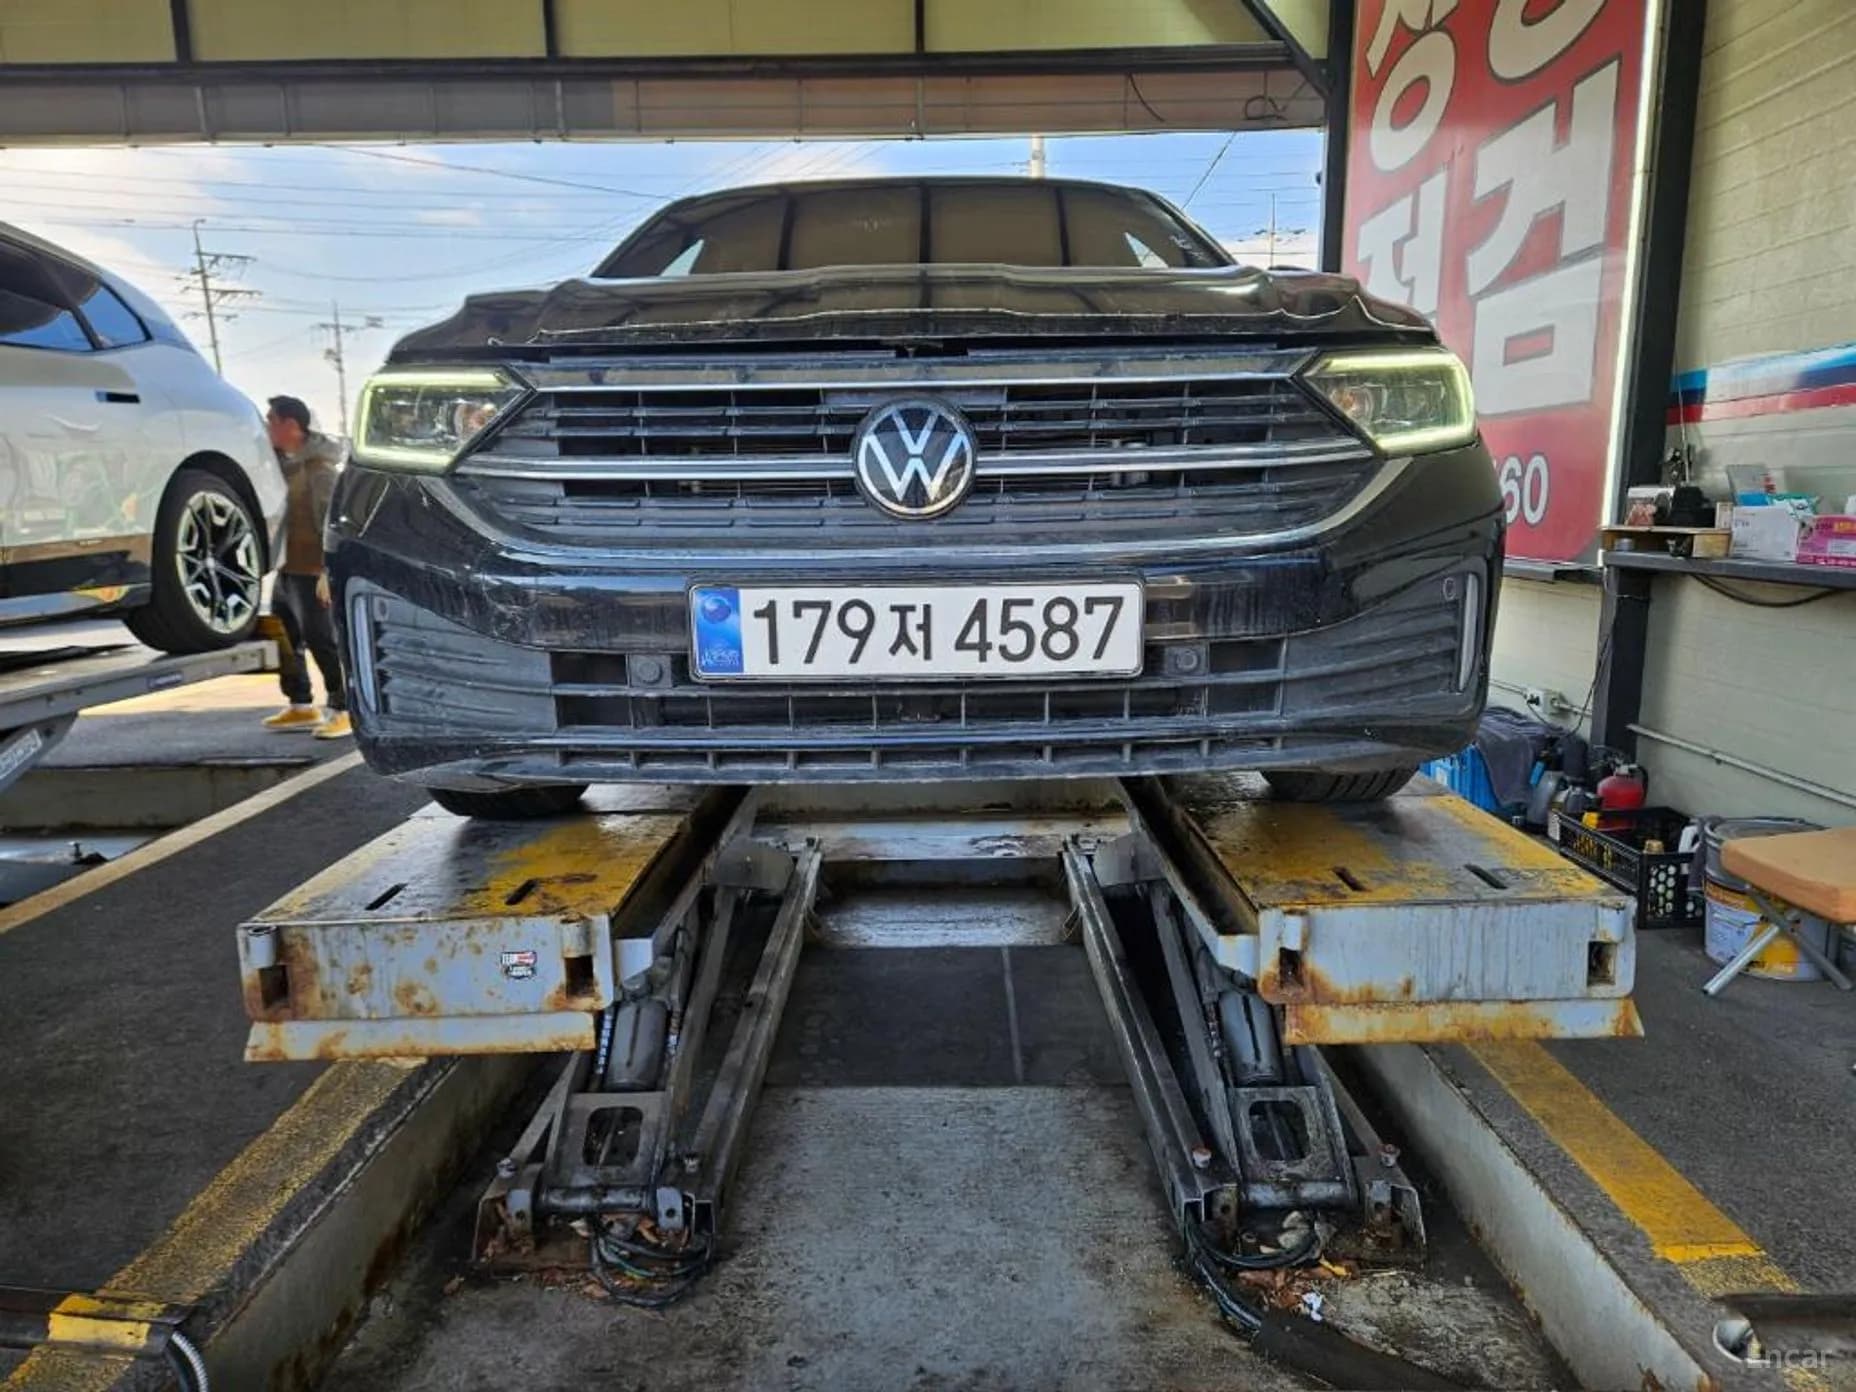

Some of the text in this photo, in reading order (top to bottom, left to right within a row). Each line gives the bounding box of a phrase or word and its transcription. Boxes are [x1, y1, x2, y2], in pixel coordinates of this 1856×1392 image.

[1494, 455, 1549, 525] 60
[753, 596, 1125, 665] 179저 4587
